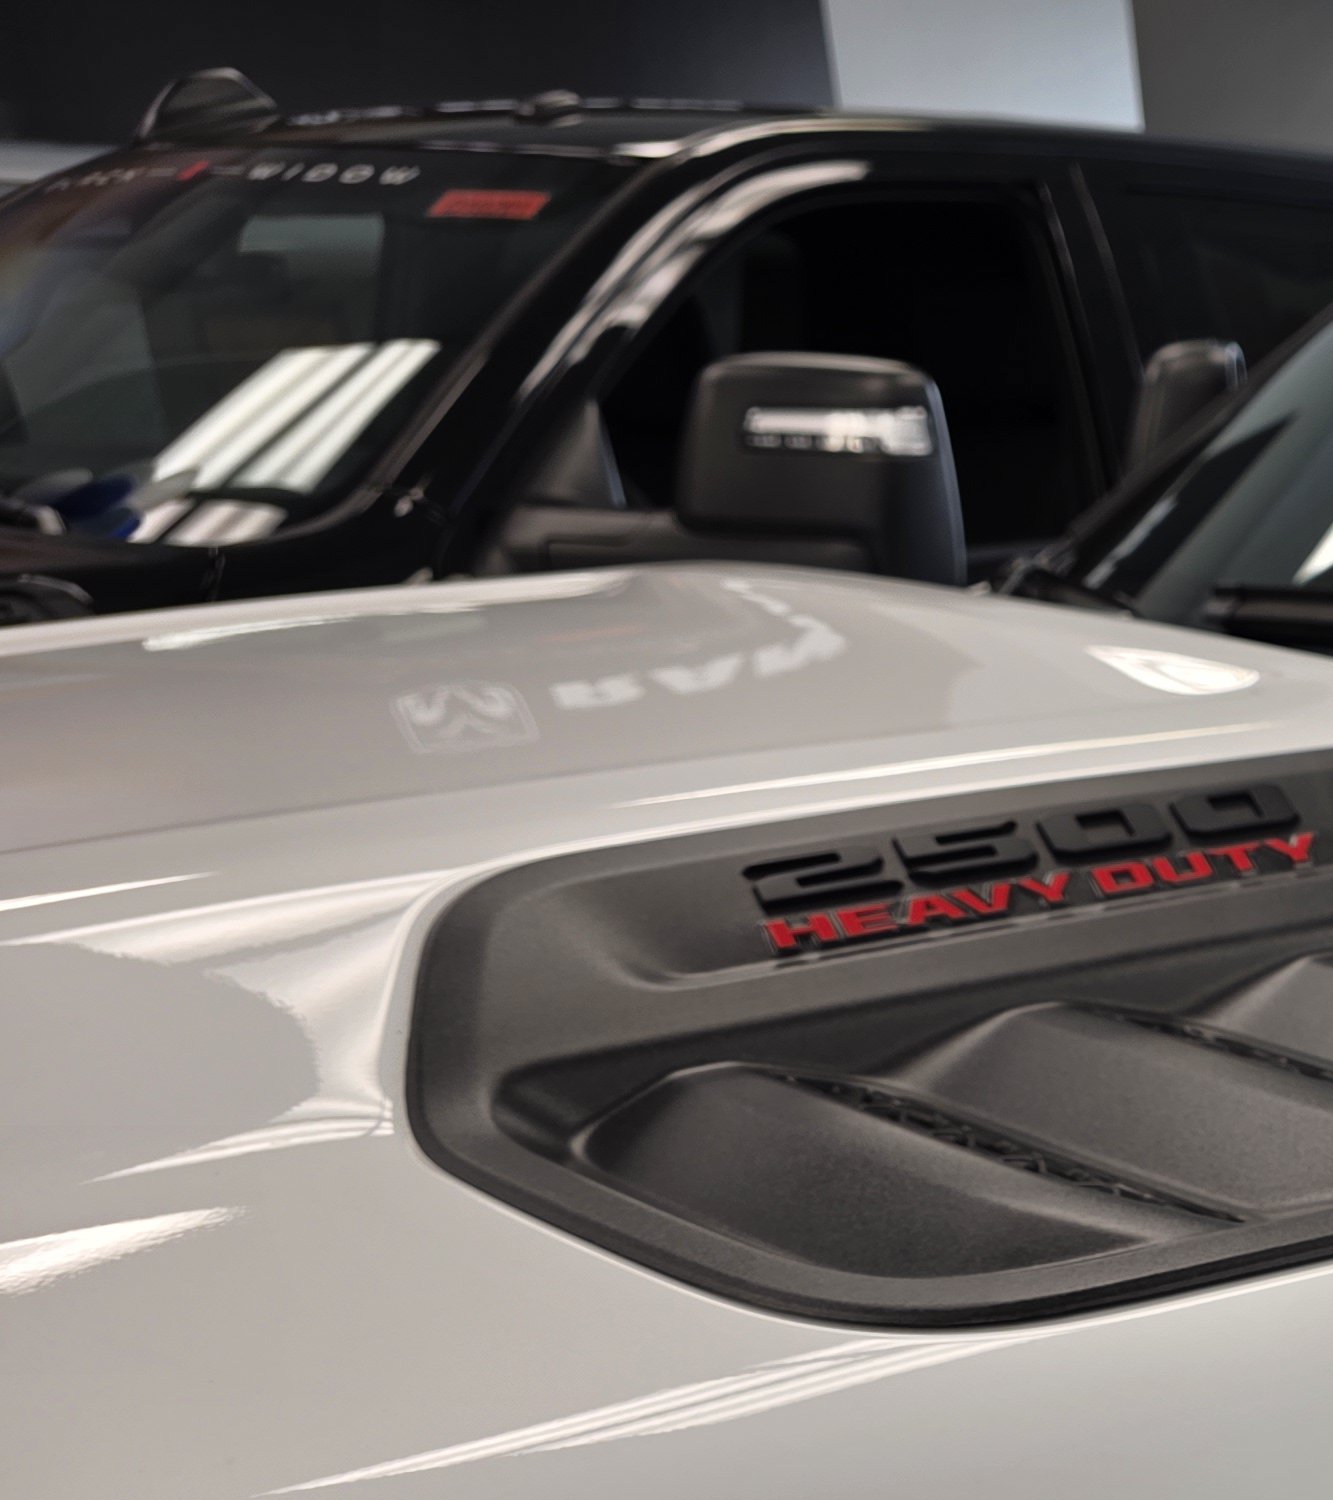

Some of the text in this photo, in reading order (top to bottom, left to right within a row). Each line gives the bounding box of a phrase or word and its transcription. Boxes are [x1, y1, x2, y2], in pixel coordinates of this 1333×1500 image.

[246, 162, 421, 186] WIDOW
[742, 783, 1301, 914] 2500
[762, 832, 1317, 953] HEAVY DUTY
